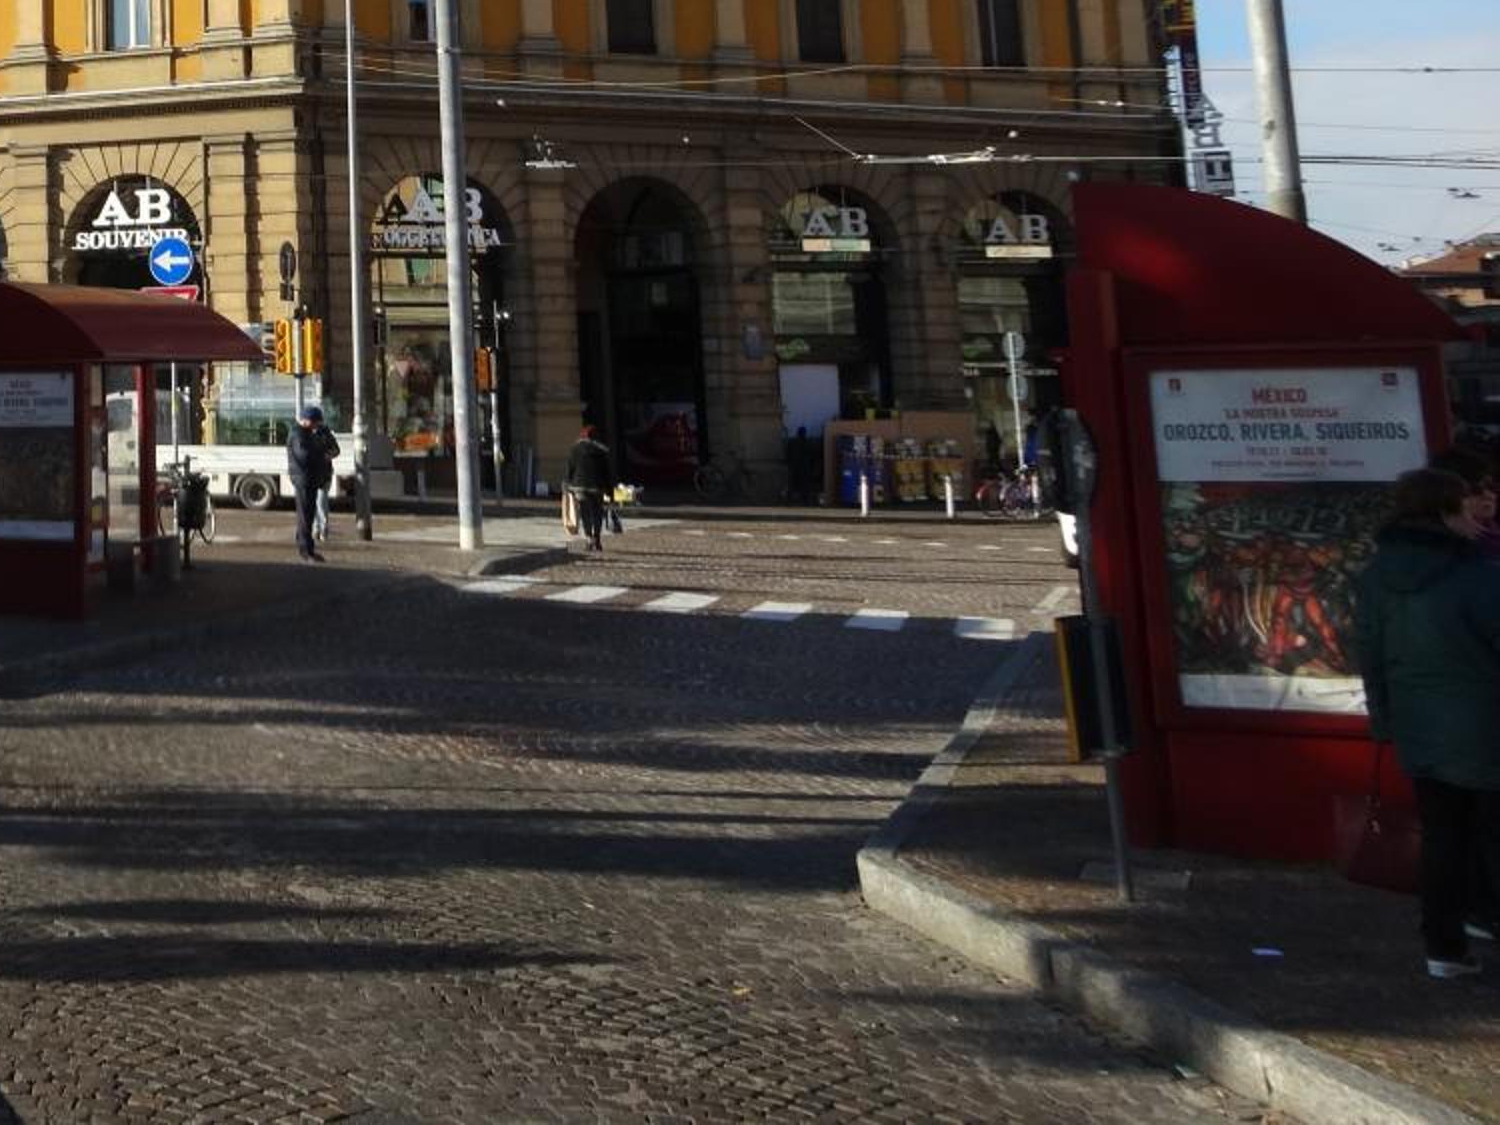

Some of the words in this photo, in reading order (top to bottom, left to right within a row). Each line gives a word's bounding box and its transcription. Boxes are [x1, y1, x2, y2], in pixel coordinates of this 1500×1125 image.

[92, 188, 171, 227] AB
[803, 206, 869, 236] AB
[986, 214, 1050, 243] AB
[1316, 421, 1410, 440] SIQUEIROS
